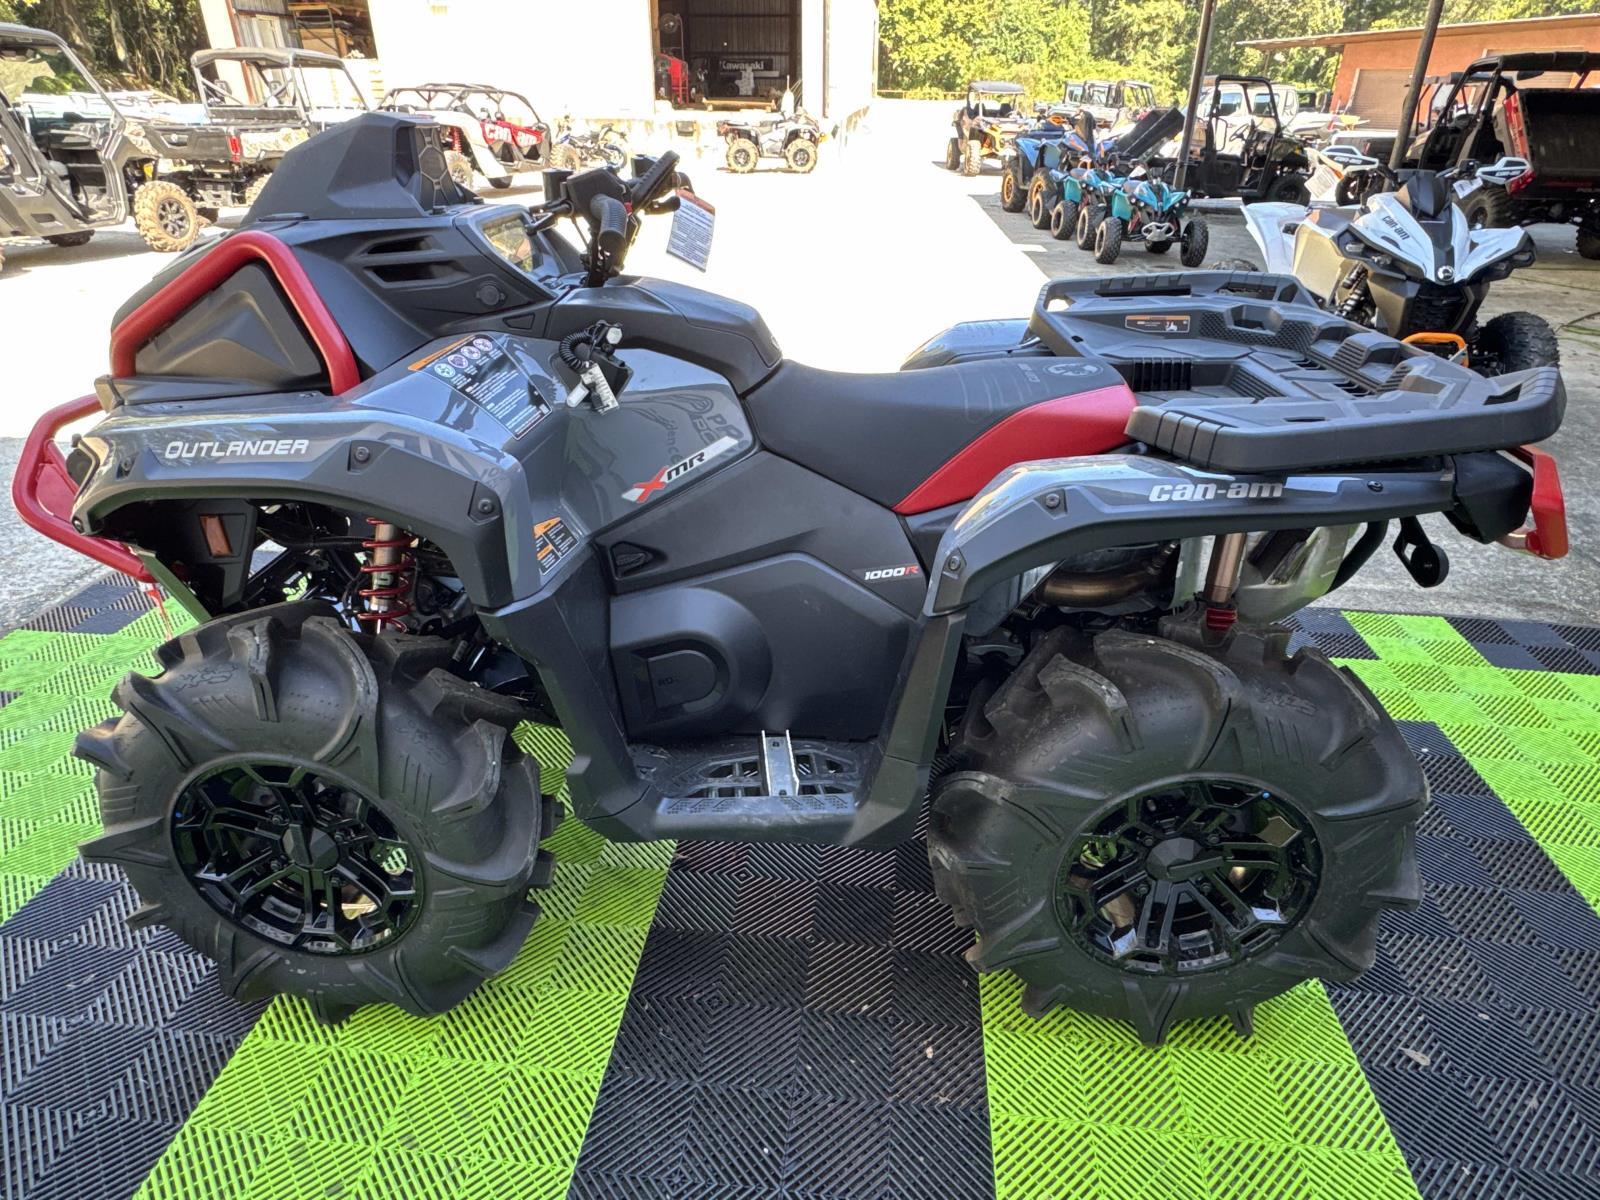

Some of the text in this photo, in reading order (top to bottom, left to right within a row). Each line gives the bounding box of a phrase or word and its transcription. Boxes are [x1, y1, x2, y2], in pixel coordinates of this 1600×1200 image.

[1382, 215, 1410, 240] can-am
[165, 439, 309, 459] OUTLANDER
[1149, 482, 1283, 501] can-am
[864, 565, 919, 581] 1000R
